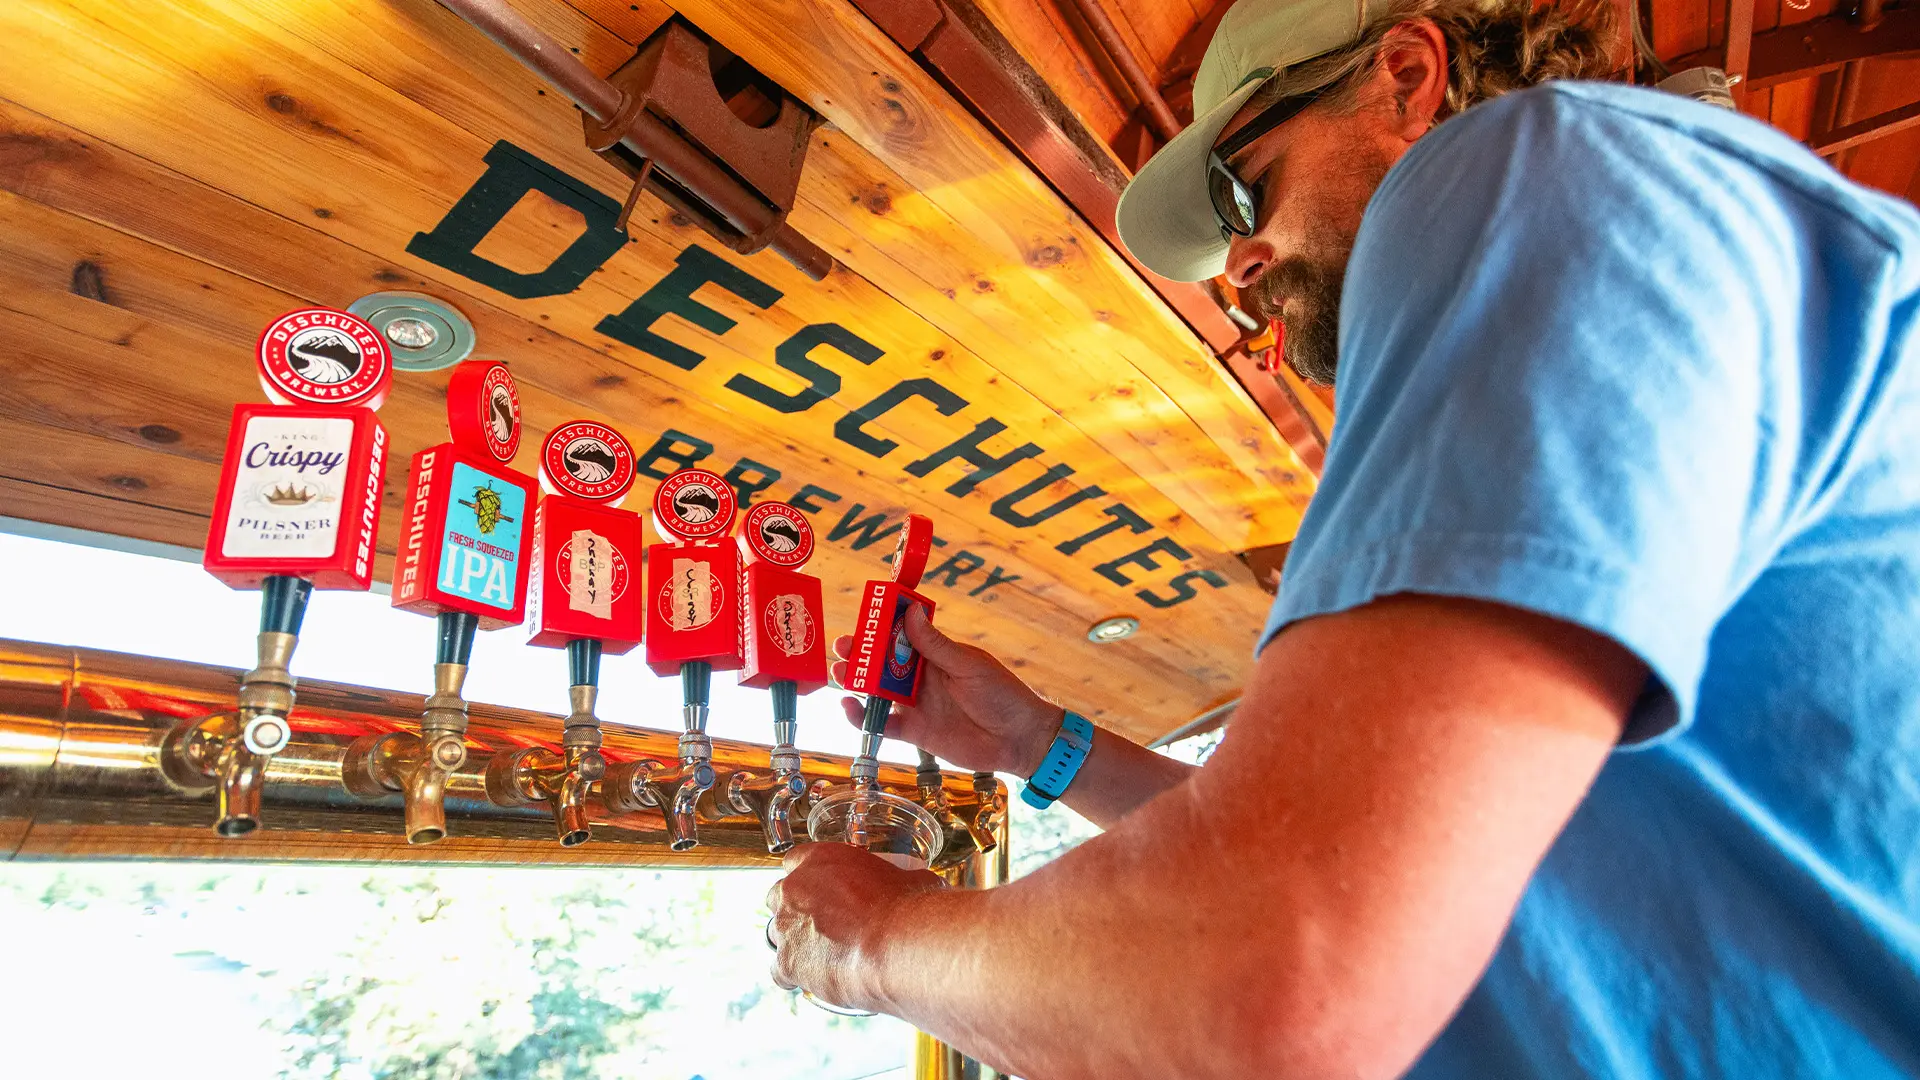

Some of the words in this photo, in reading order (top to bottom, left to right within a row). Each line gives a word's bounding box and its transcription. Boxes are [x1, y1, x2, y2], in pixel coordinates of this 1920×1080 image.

[273, 314, 378, 356] DESCHUTES
[280, 371, 362, 397] BREWERY
[405, 139, 1228, 609] DESCHUTES
[486, 371, 520, 424] DESCHUTES
[485, 420, 511, 455] BREWERY
[551, 427, 627, 459] DESCHUTES
[245, 442, 345, 475] Crispy
[561, 474, 619, 494] BREWERY
[663, 475, 729, 500] DESCHUTES
[355, 424, 385, 579] DESCHUTES
[238, 518, 331, 531] PILSNER
[400, 451, 436, 599] DESCHUTES
[670, 517, 722, 533] BREWERY
[751, 506, 807, 533] DESCHUTES
[449, 531, 475, 549] FRESH
[476, 536, 515, 562] SQUEEZED
[759, 544, 802, 562] BREWERY
[442, 543, 512, 605] IPA
[852, 585, 886, 689] DESCHUTES
